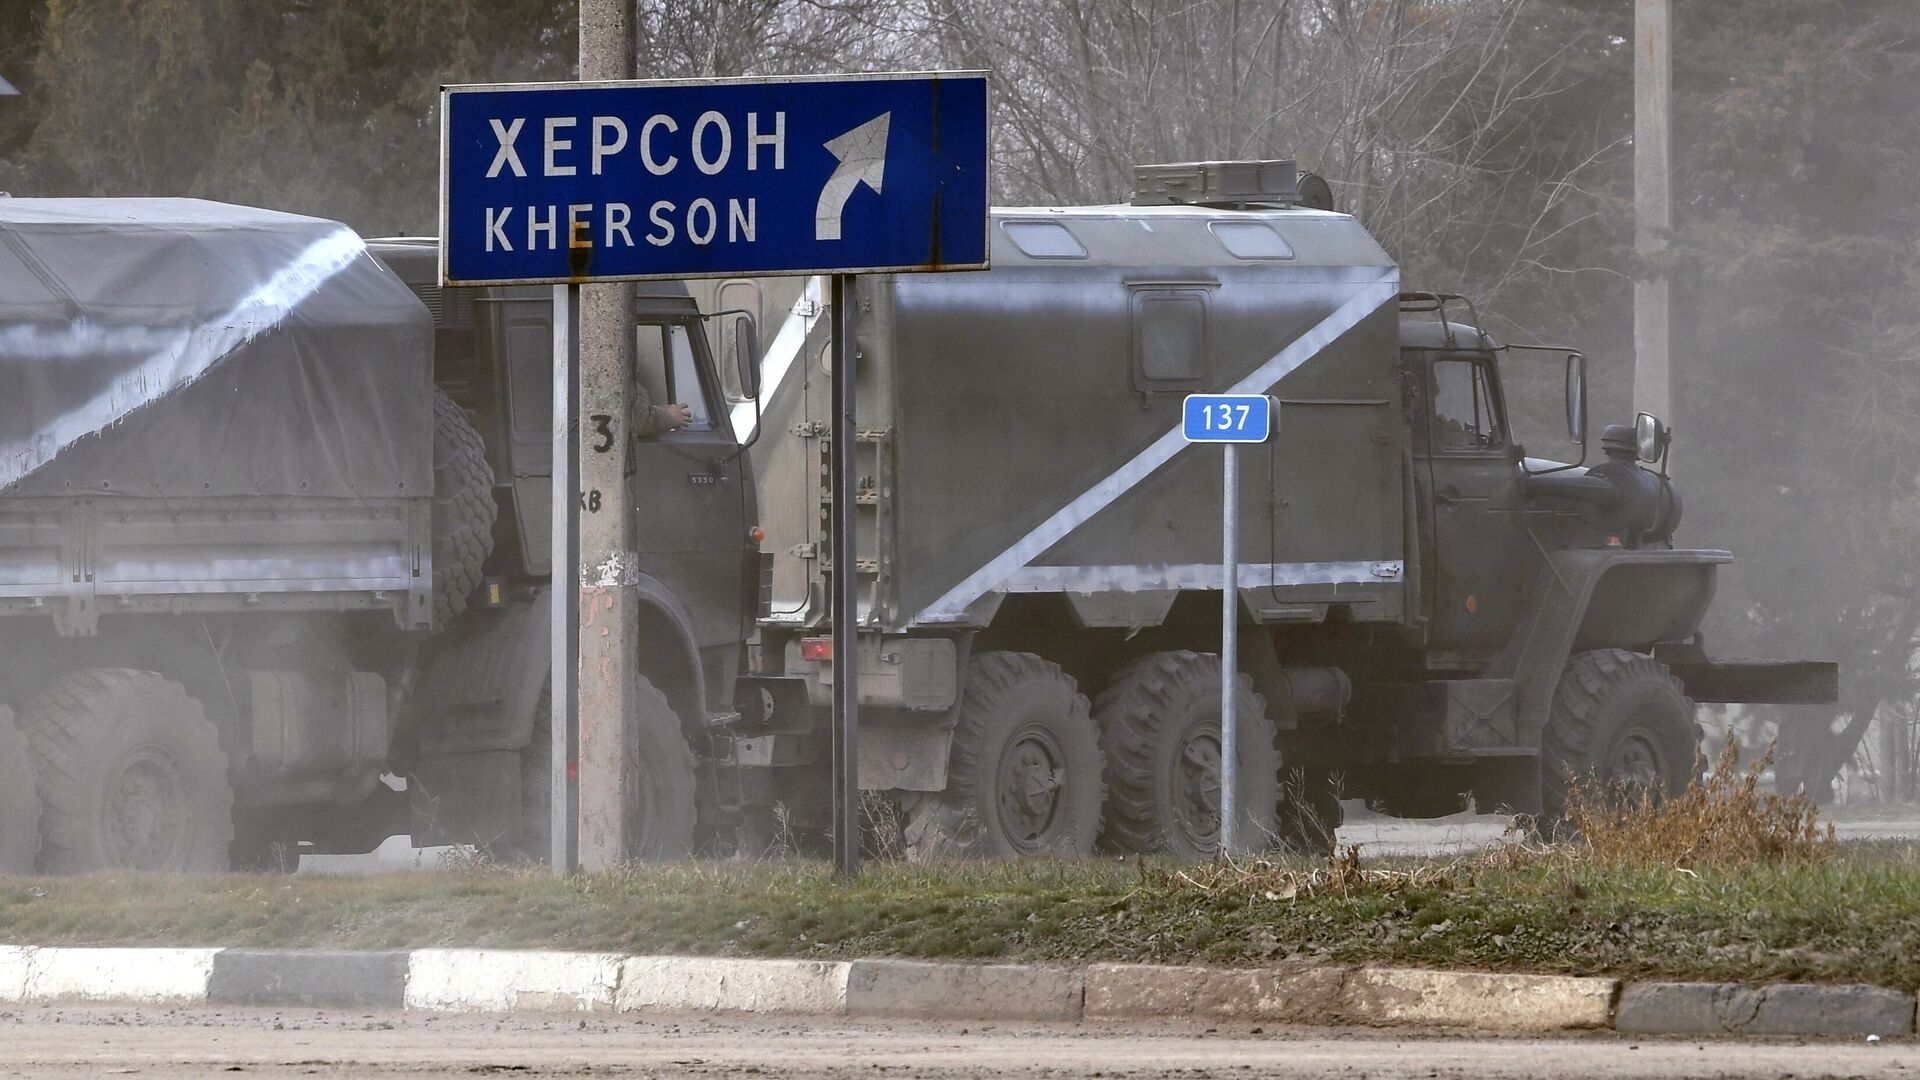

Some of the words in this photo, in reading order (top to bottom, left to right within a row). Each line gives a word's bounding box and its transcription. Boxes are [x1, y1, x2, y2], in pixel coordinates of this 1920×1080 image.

[485, 110, 787, 178] ХЕРСОН
[485, 197, 756, 252] KHERSON
[1202, 403, 1251, 431] 137
